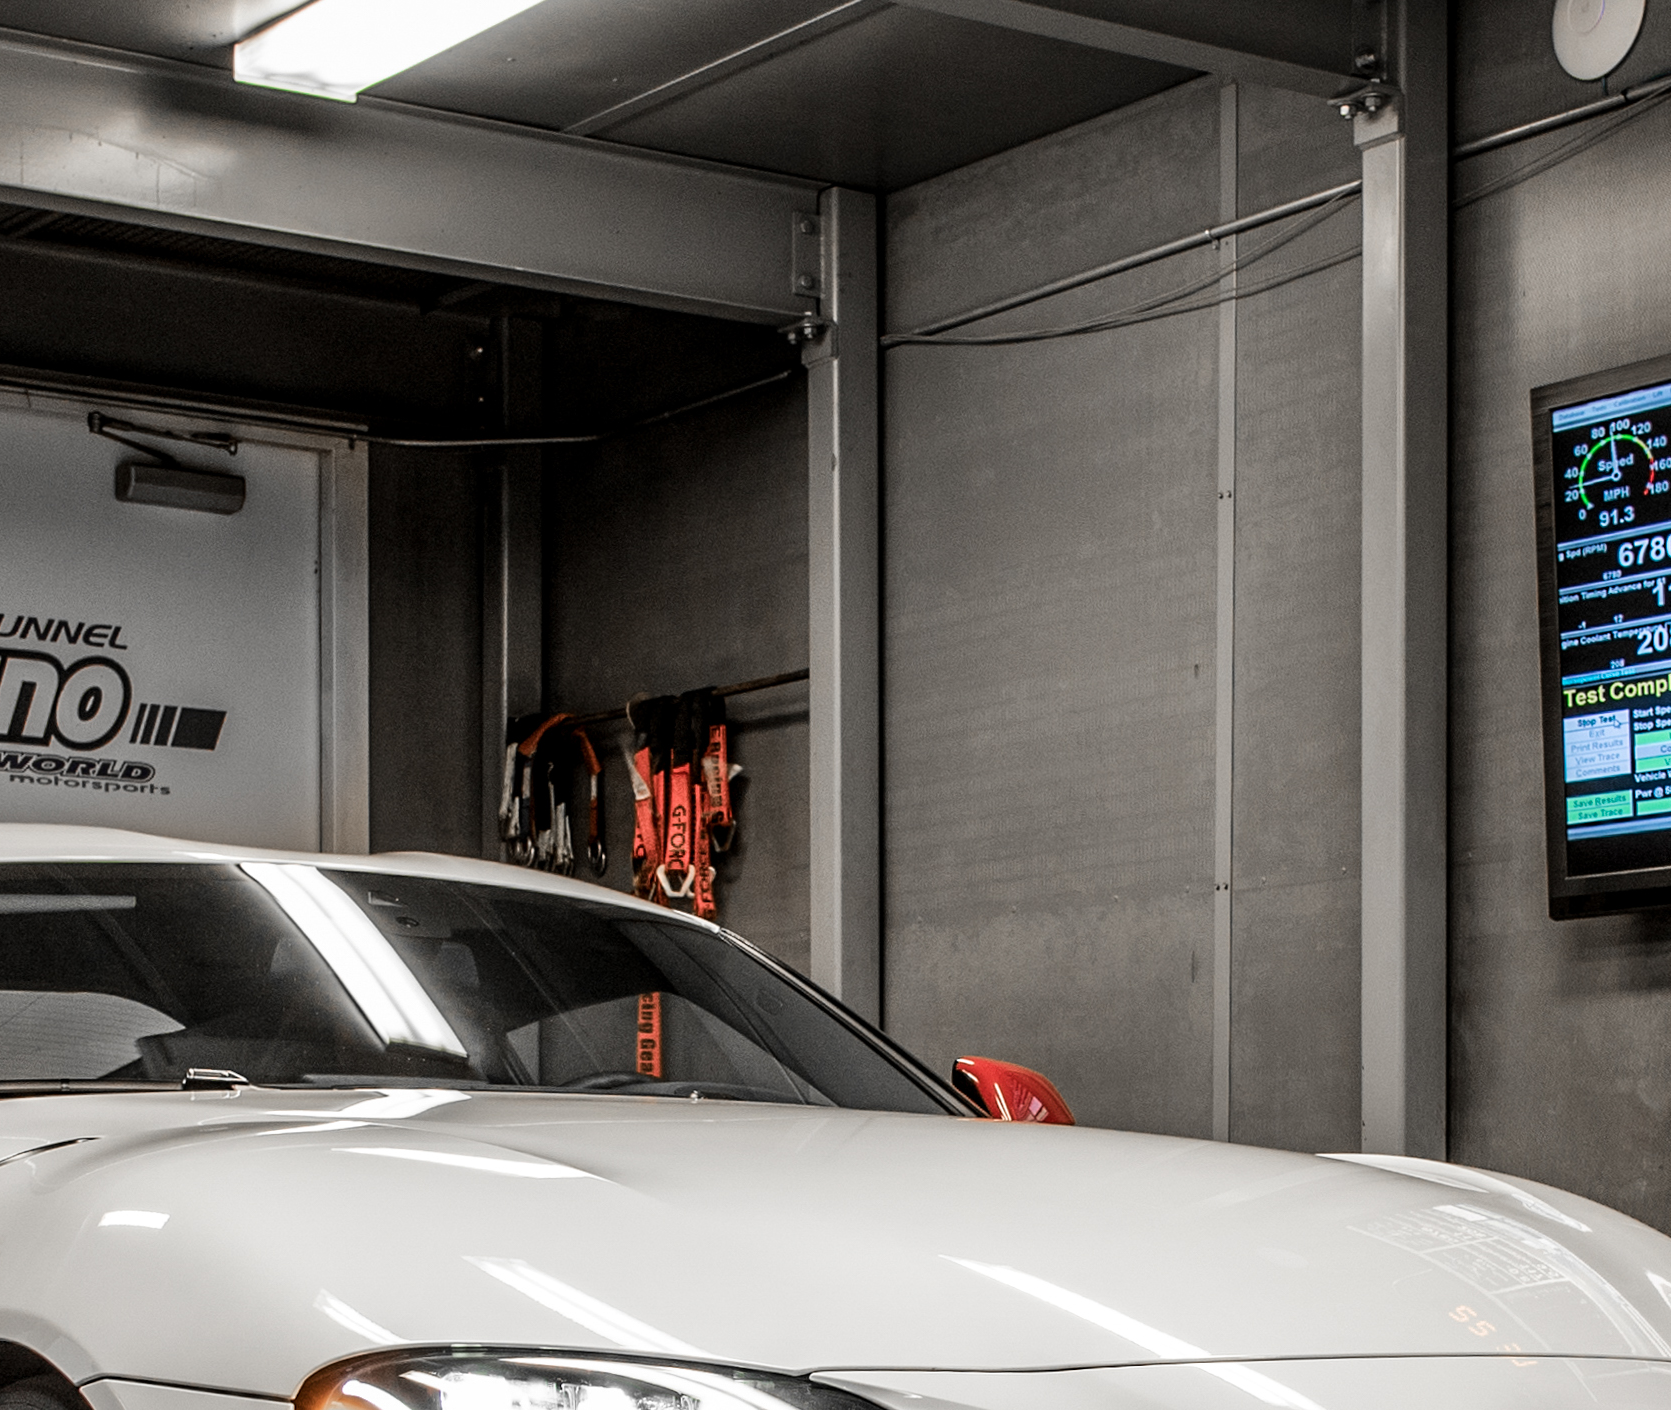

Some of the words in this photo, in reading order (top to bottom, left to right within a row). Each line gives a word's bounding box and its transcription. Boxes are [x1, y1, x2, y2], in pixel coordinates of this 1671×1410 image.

[1591, 427, 1605, 439] 80
[1631, 421, 1651, 435] 120
[1646, 435, 1667, 449] 140
[1574, 444, 1588, 457] 60
[1564, 467, 1578, 479] 40
[1565, 490, 1579, 502] 20
[1603, 486, 1630, 501] MPH
[1578, 509, 1587, 520] 0
[1599, 505, 1635, 527] 91.3
[1563, 684, 1606, 708] Test
[1632, 708, 1654, 719] Start
[1577, 718, 1596, 729] Stop
[1633, 720, 1654, 732] Stop
[1570, 742, 1591, 753] Print
[1591, 739, 1623, 751] Results
[1575, 755, 1595, 766] View
[1597, 752, 1620, 762] Trace
[1575, 765, 1620, 779] Comments
[1634, 770, 1667, 783] Vehicle
[9, 773, 172, 797] motorsports
[1573, 797, 1593, 808] Save
[1594, 793, 1626, 805] Results
[1578, 809, 1598, 820] Save
[1600, 806, 1623, 818] Trace
[639, 1039, 656, 1074] Gea
